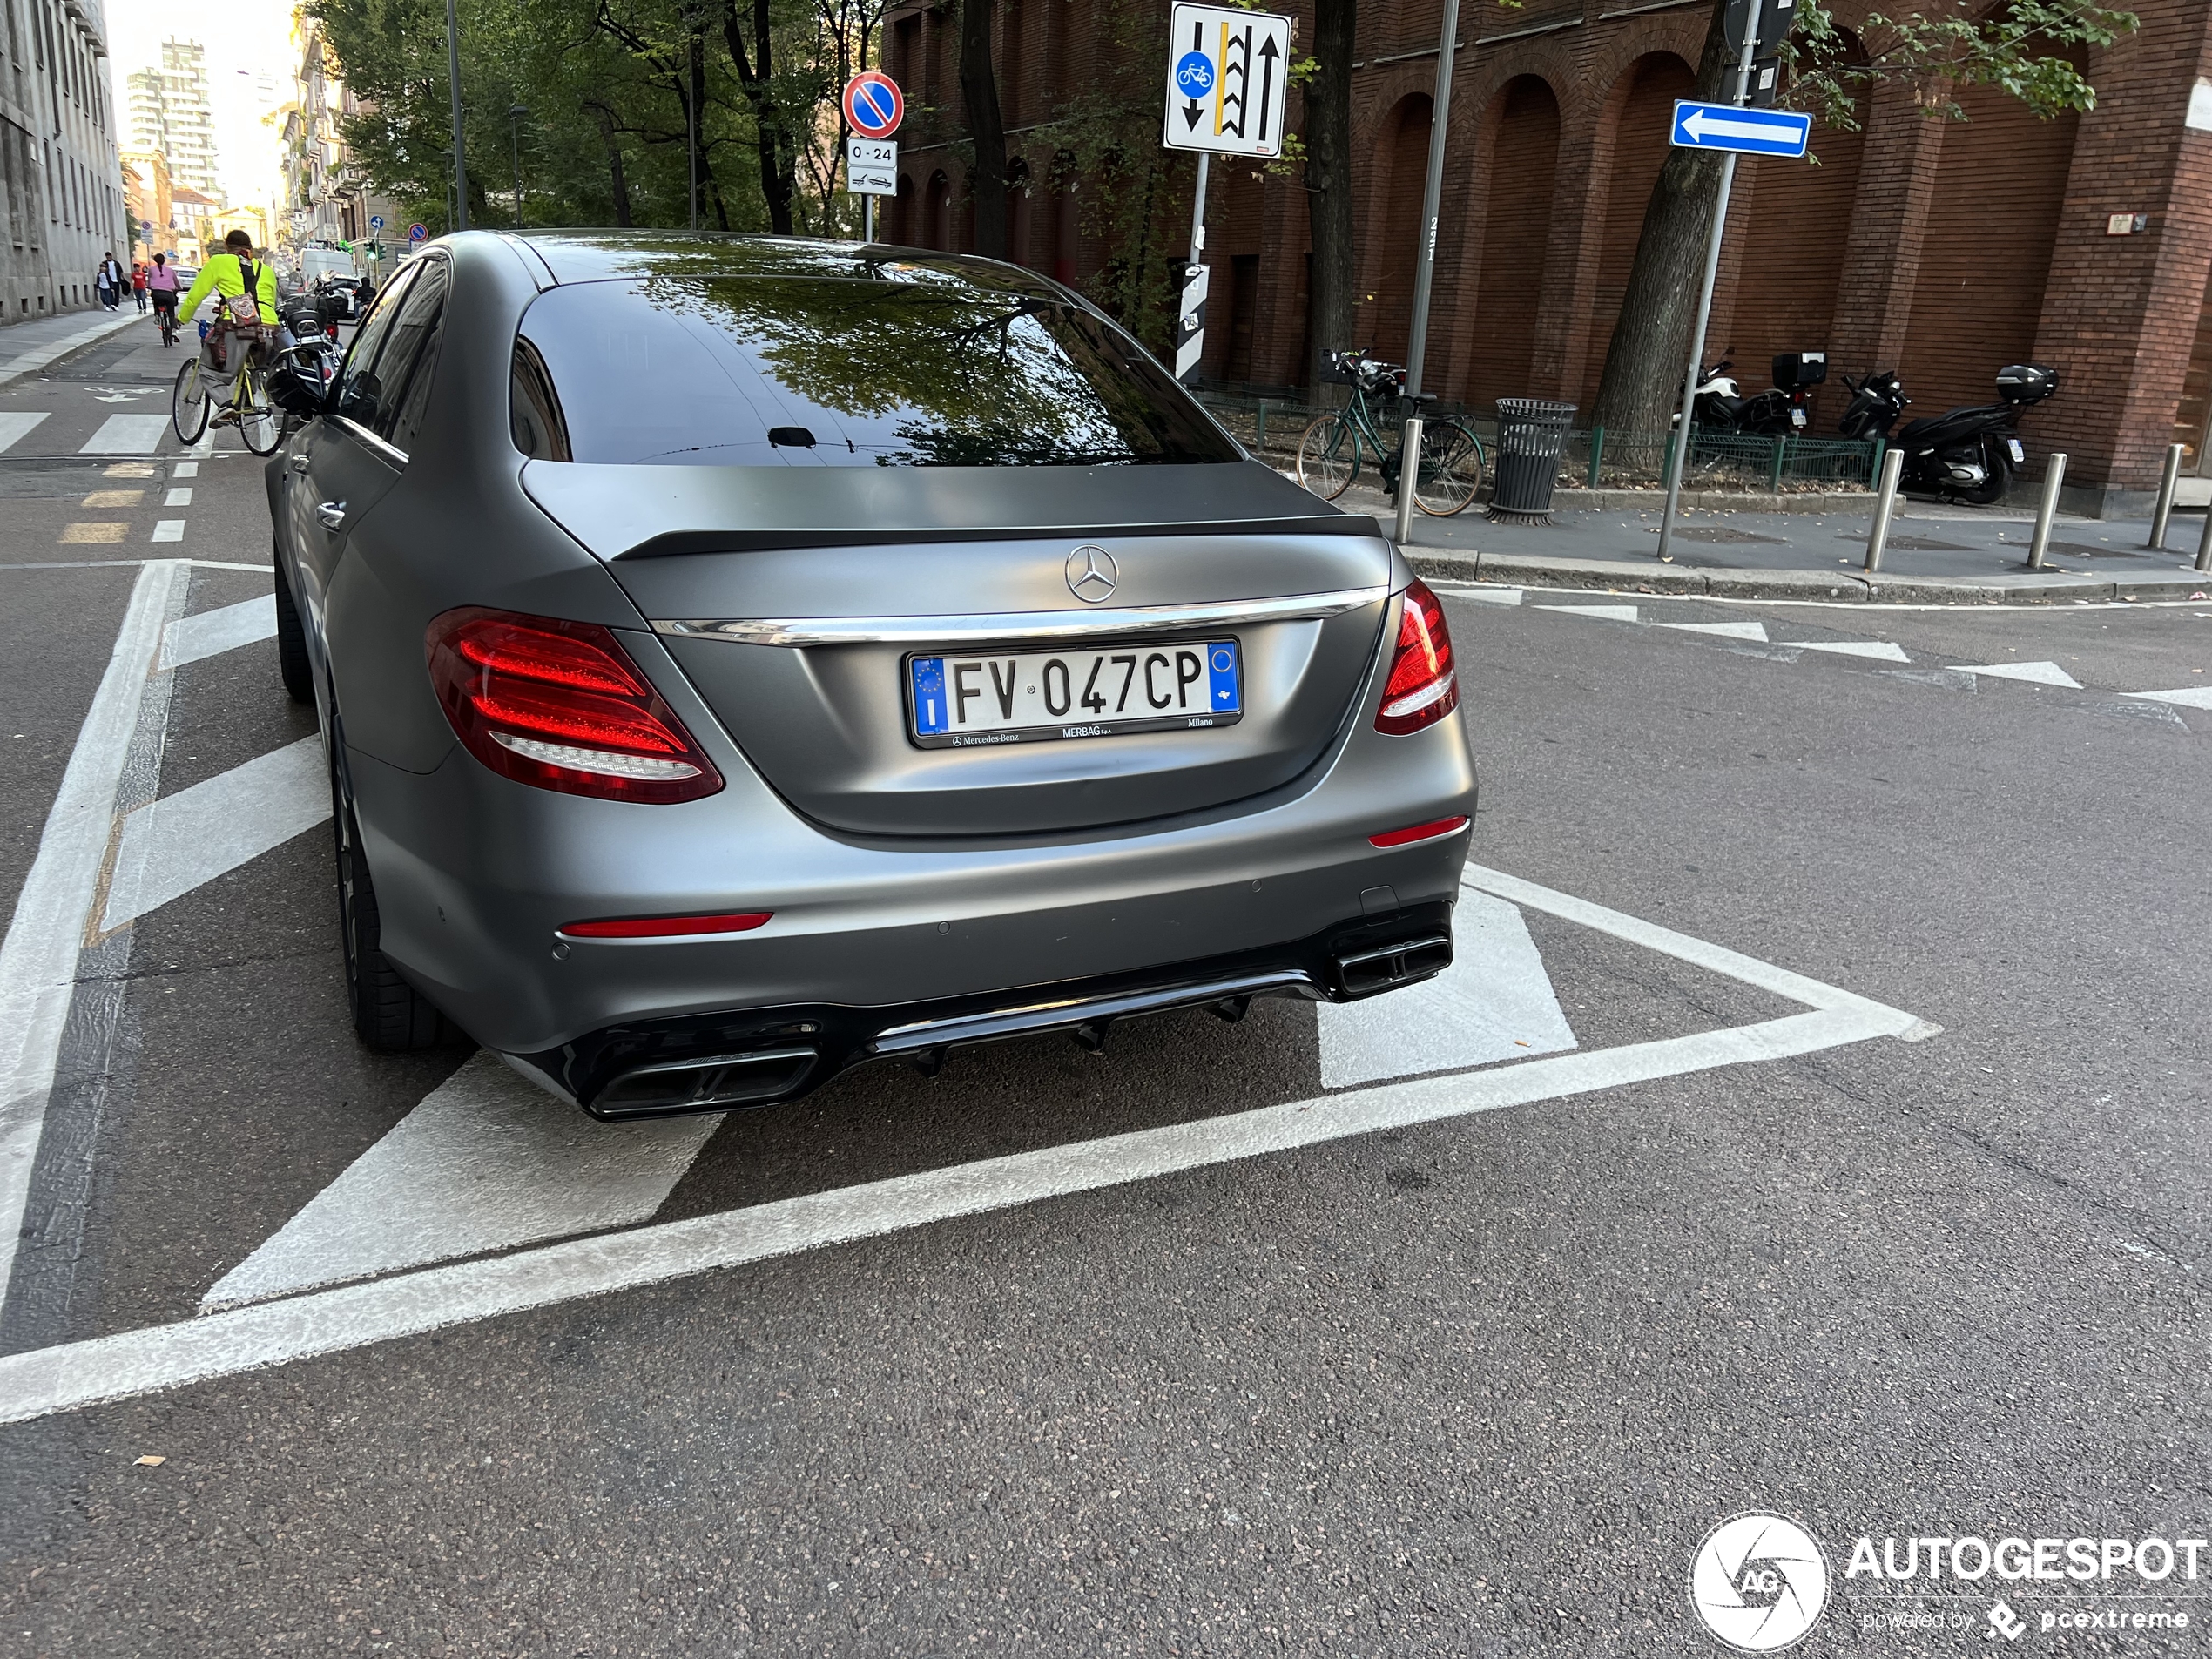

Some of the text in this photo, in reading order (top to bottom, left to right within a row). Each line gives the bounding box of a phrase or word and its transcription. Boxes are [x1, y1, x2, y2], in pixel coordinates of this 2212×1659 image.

[853, 146, 861, 158] 0
[873, 148, 892, 161] 24
[953, 651, 1202, 723] FV 047CP
[1188, 718, 1213, 727] Milano
[1062, 725, 1101, 738] MERBAG
[963, 734, 1019, 745] Mercedes-Benz
